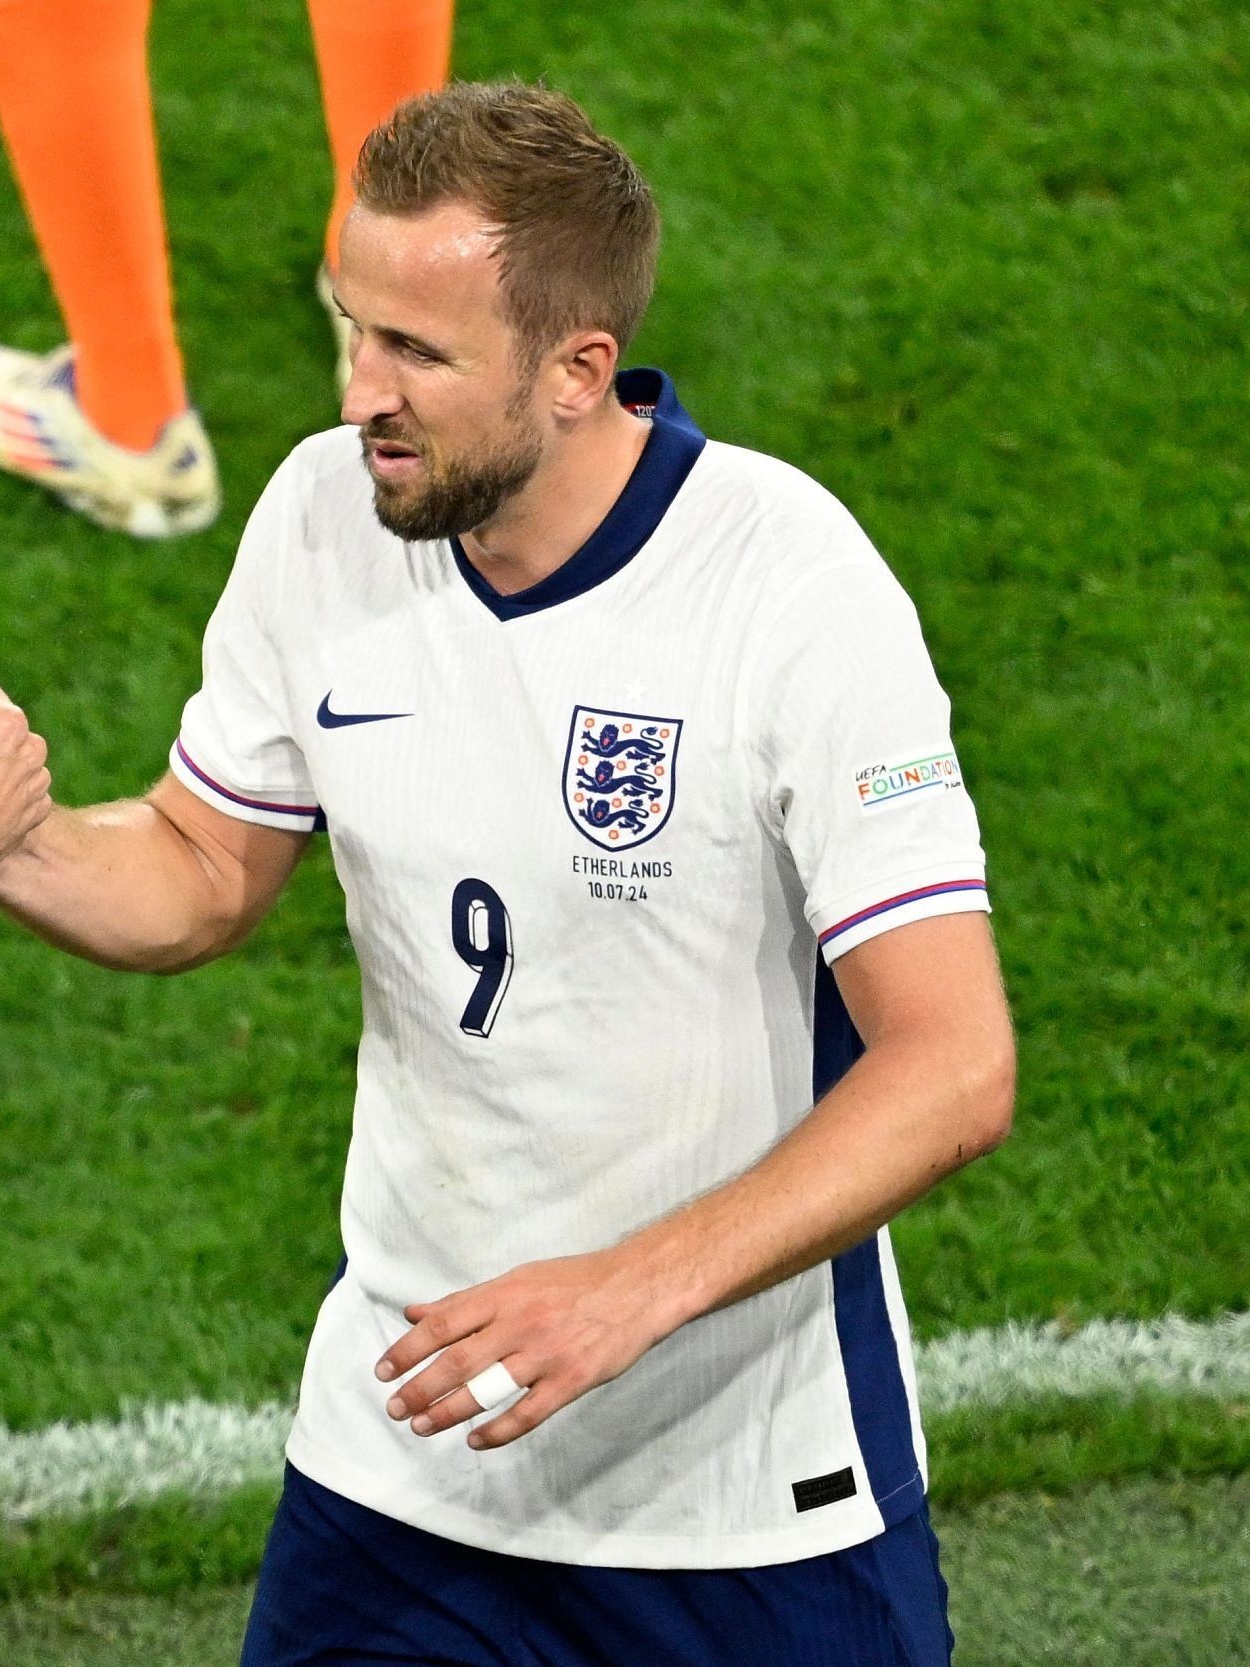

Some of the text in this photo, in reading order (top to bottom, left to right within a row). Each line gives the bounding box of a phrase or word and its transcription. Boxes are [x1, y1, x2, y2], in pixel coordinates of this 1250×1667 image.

[855, 765, 887, 782] UEFA
[858, 759, 959, 801] FOUNDATION
[573, 855, 672, 878] ETHERLANDS
[588, 881, 648, 902] 10.07.24
[452, 878, 514, 1039] 9
